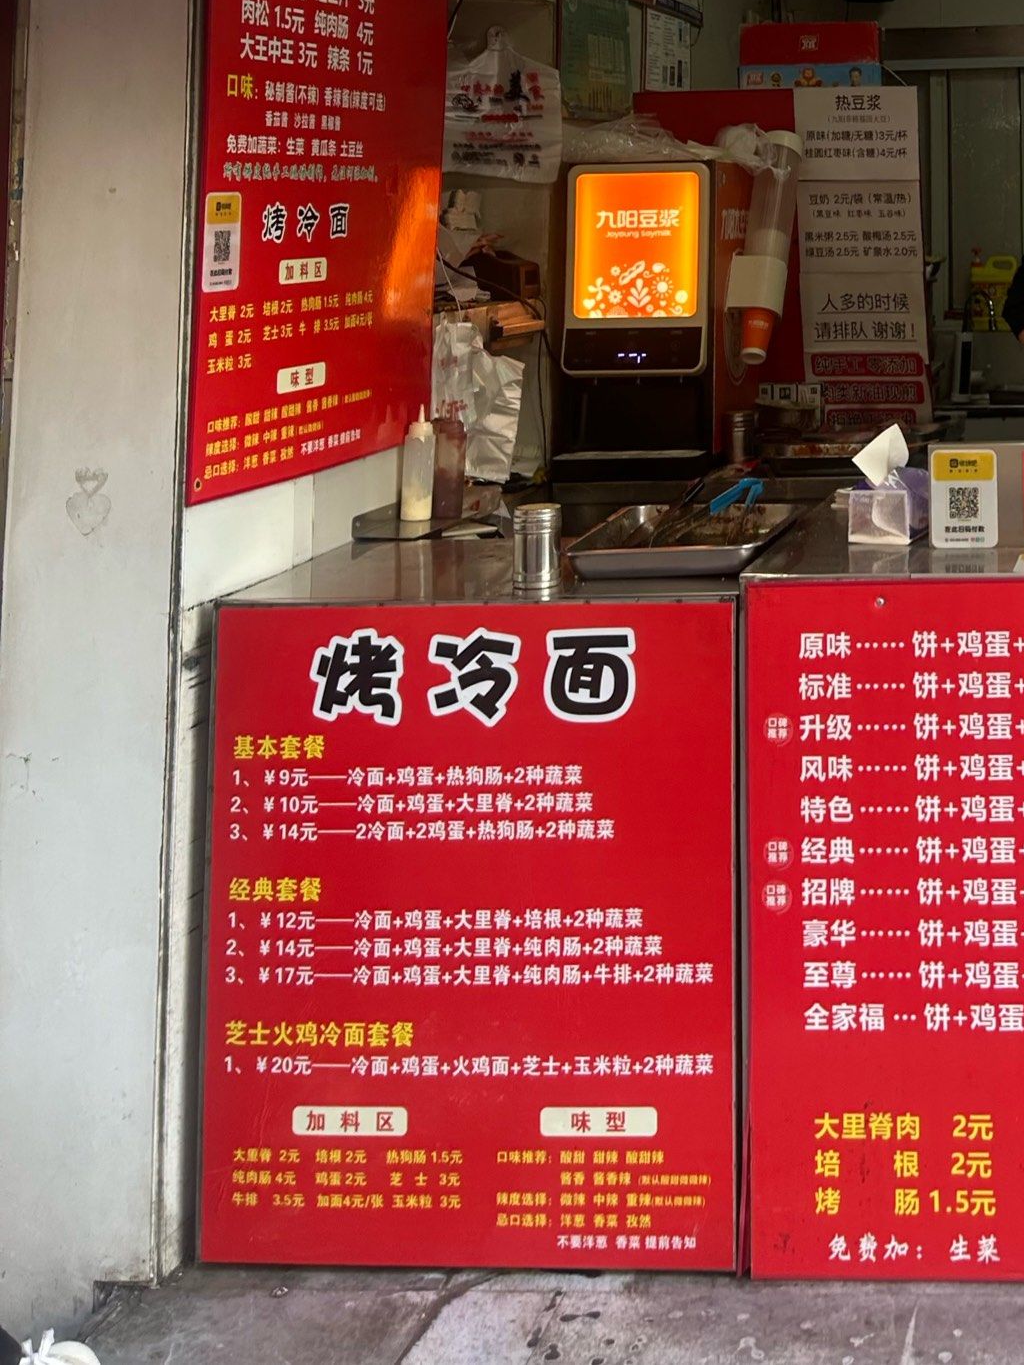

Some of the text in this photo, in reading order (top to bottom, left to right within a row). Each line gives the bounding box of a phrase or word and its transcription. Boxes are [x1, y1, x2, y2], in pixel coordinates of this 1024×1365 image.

[274, 5, 305, 34] 1.5元
[314, 10, 349, 40] 纯肉肠
[356, 22, 374, 46] 4元
[240, 32, 373, 75] 大王中王 3元 辣条 1元
[835, 95, 881, 111] 热豆浆
[262, 201, 350, 243] 烤冷面
[596, 209, 680, 229] 九阳豆浆
[822, 293, 910, 311] 人多的时候
[815, 321, 867, 339] 请排队
[799, 632, 851, 659] 原味
[310, 626, 635, 727] 烤冷面
[799, 673, 851, 700] 标准
[800, 714, 852, 741] 升级
[233, 735, 326, 760] 基本套餐
[800, 755, 853, 782] 风味
[801, 796, 853, 823] 特色
[801, 837, 854, 864] 经典
[229, 877, 322, 903] 经典套餐
[802, 878, 855, 905] 招牌
[803, 919, 856, 947] 豪华
[803, 961, 857, 989] 至尊
[804, 1003, 884, 1031] 全家福
[224, 1020, 415, 1049] 芝士火鸡冷面套餐
[306, 1110, 395, 1132] 加料区
[571, 1111, 626, 1133] 味型
[815, 1112, 920, 1140] 大里脊肉
[953, 1115, 993, 1140] 2元
[279, 1149, 300, 1163] 2元
[315, 1149, 341, 1163] 培根
[345, 1149, 367, 1164] 2元
[431, 1151, 463, 1164] 1.5元
[951, 1152, 992, 1178] 2元
[232, 1171, 271, 1185] 纯肉肠
[275, 1172, 296, 1186] 4元
[315, 1171, 341, 1185] 鸡蛋
[345, 1172, 367, 1186] 2元
[439, 1173, 461, 1186] 3元
[232, 1192, 259, 1206] 牛排
[273, 1193, 305, 1207] 3.5元
[392, 1195, 432, 1209] 玉米粒
[440, 1195, 461, 1208] 3元
[930, 1190, 996, 1216] 1.5元
[949, 1235, 1000, 1263] 生菜
